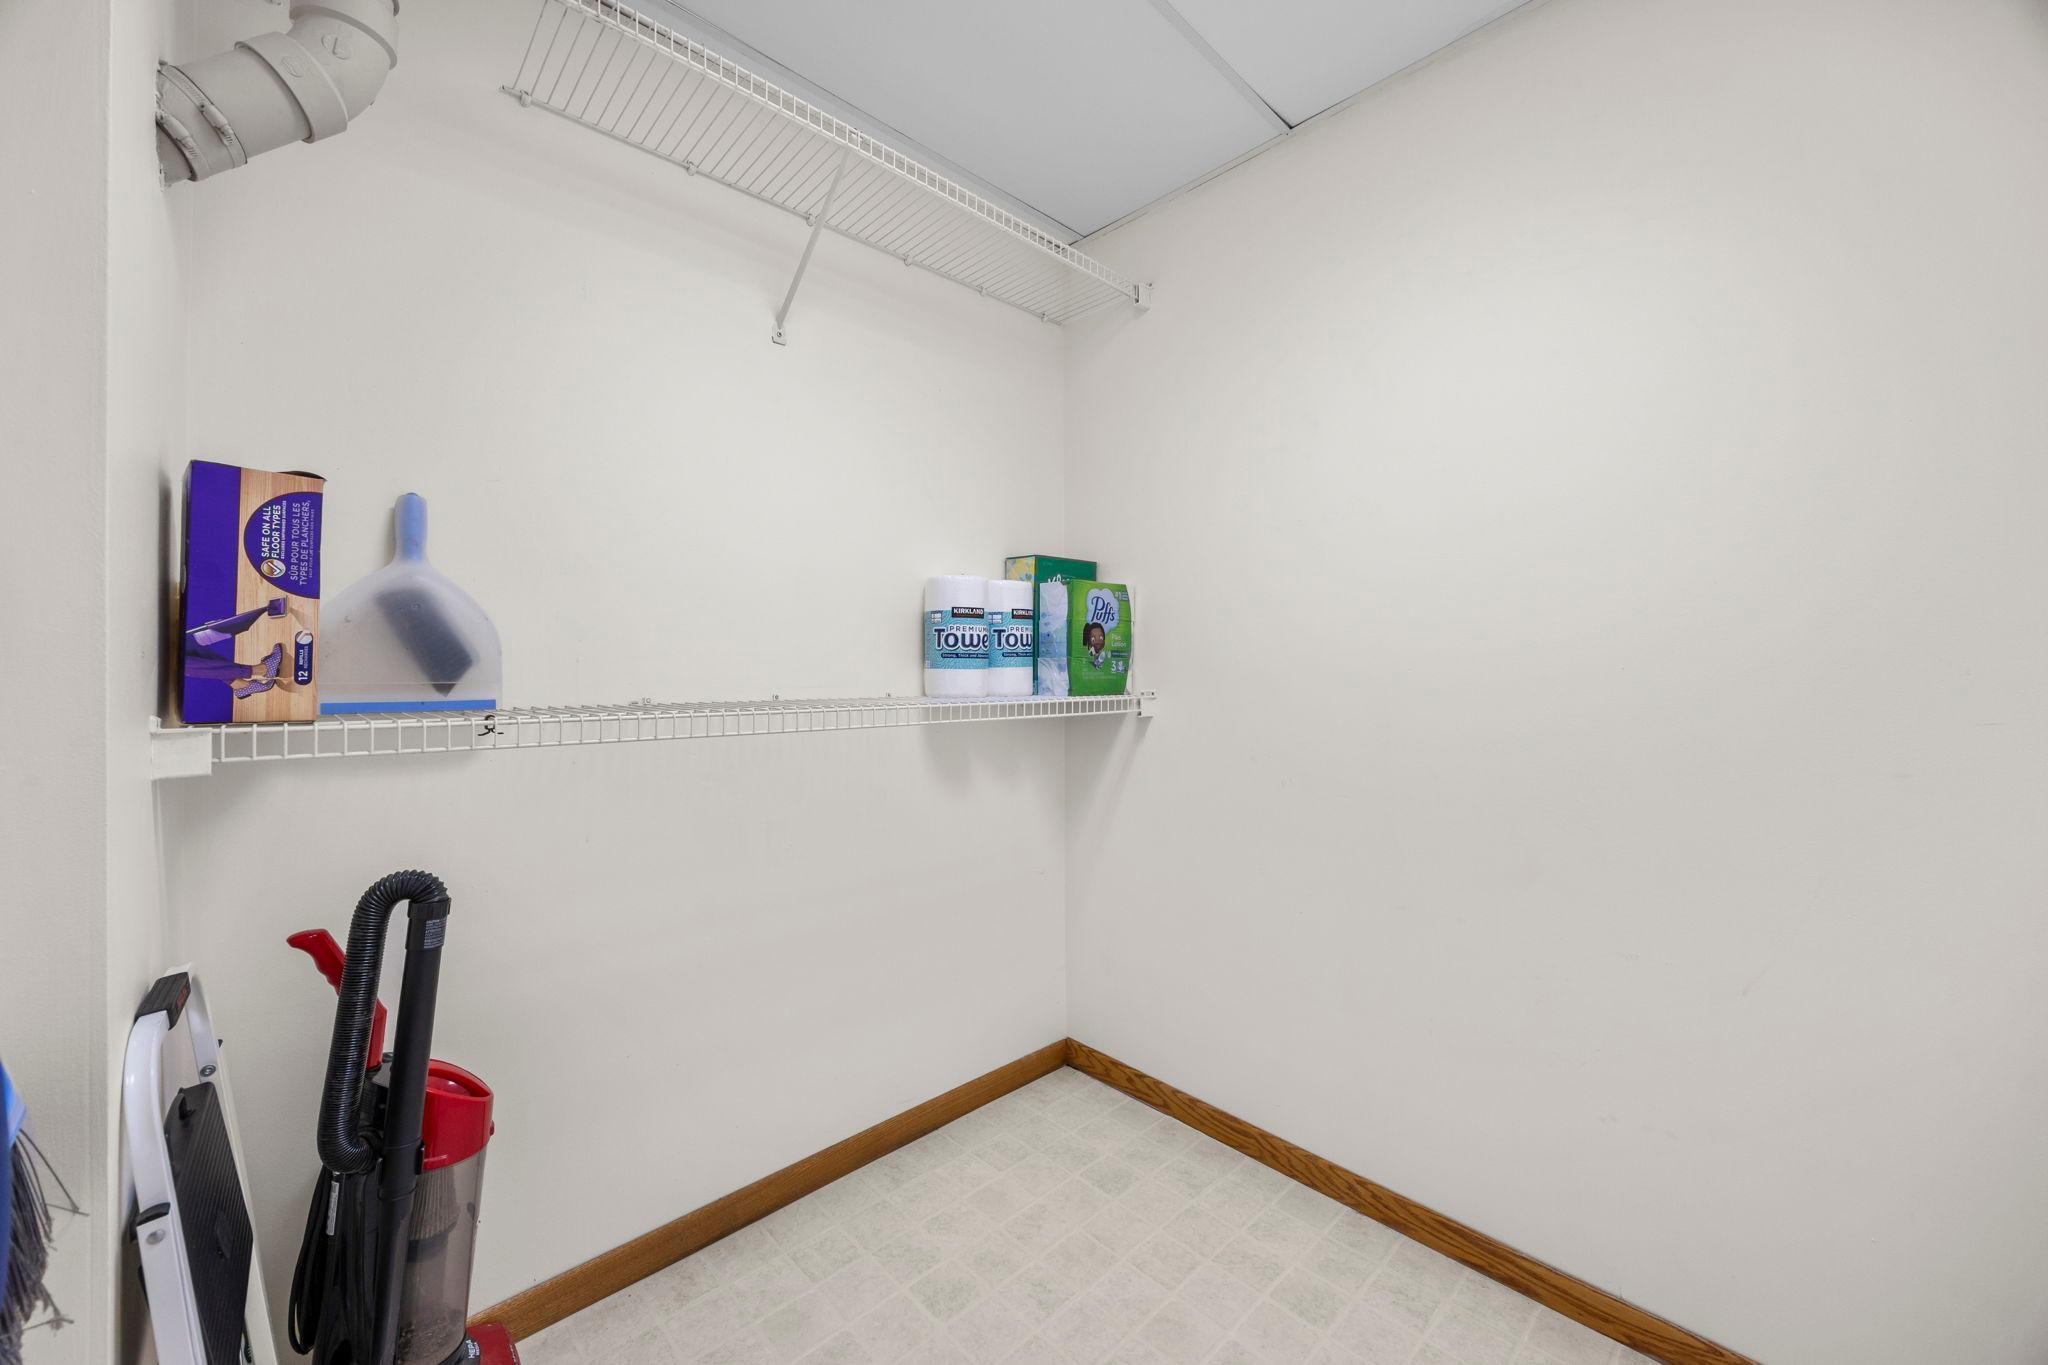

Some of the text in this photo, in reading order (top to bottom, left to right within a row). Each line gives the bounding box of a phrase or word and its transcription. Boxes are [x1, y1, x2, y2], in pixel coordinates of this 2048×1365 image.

[261, 506, 272, 558] SAFE ON ALL
[271, 504, 282, 558] FLOOR TYPES
[288, 502, 300, 581] SÛR POUR TOUS LES
[300, 500, 311, 586] TYPES DE PLANCHERS,
[1091, 596, 1115, 624] Puffs
[298, 670, 308, 681] 12
[466, 1340, 476, 1358] HEPA
